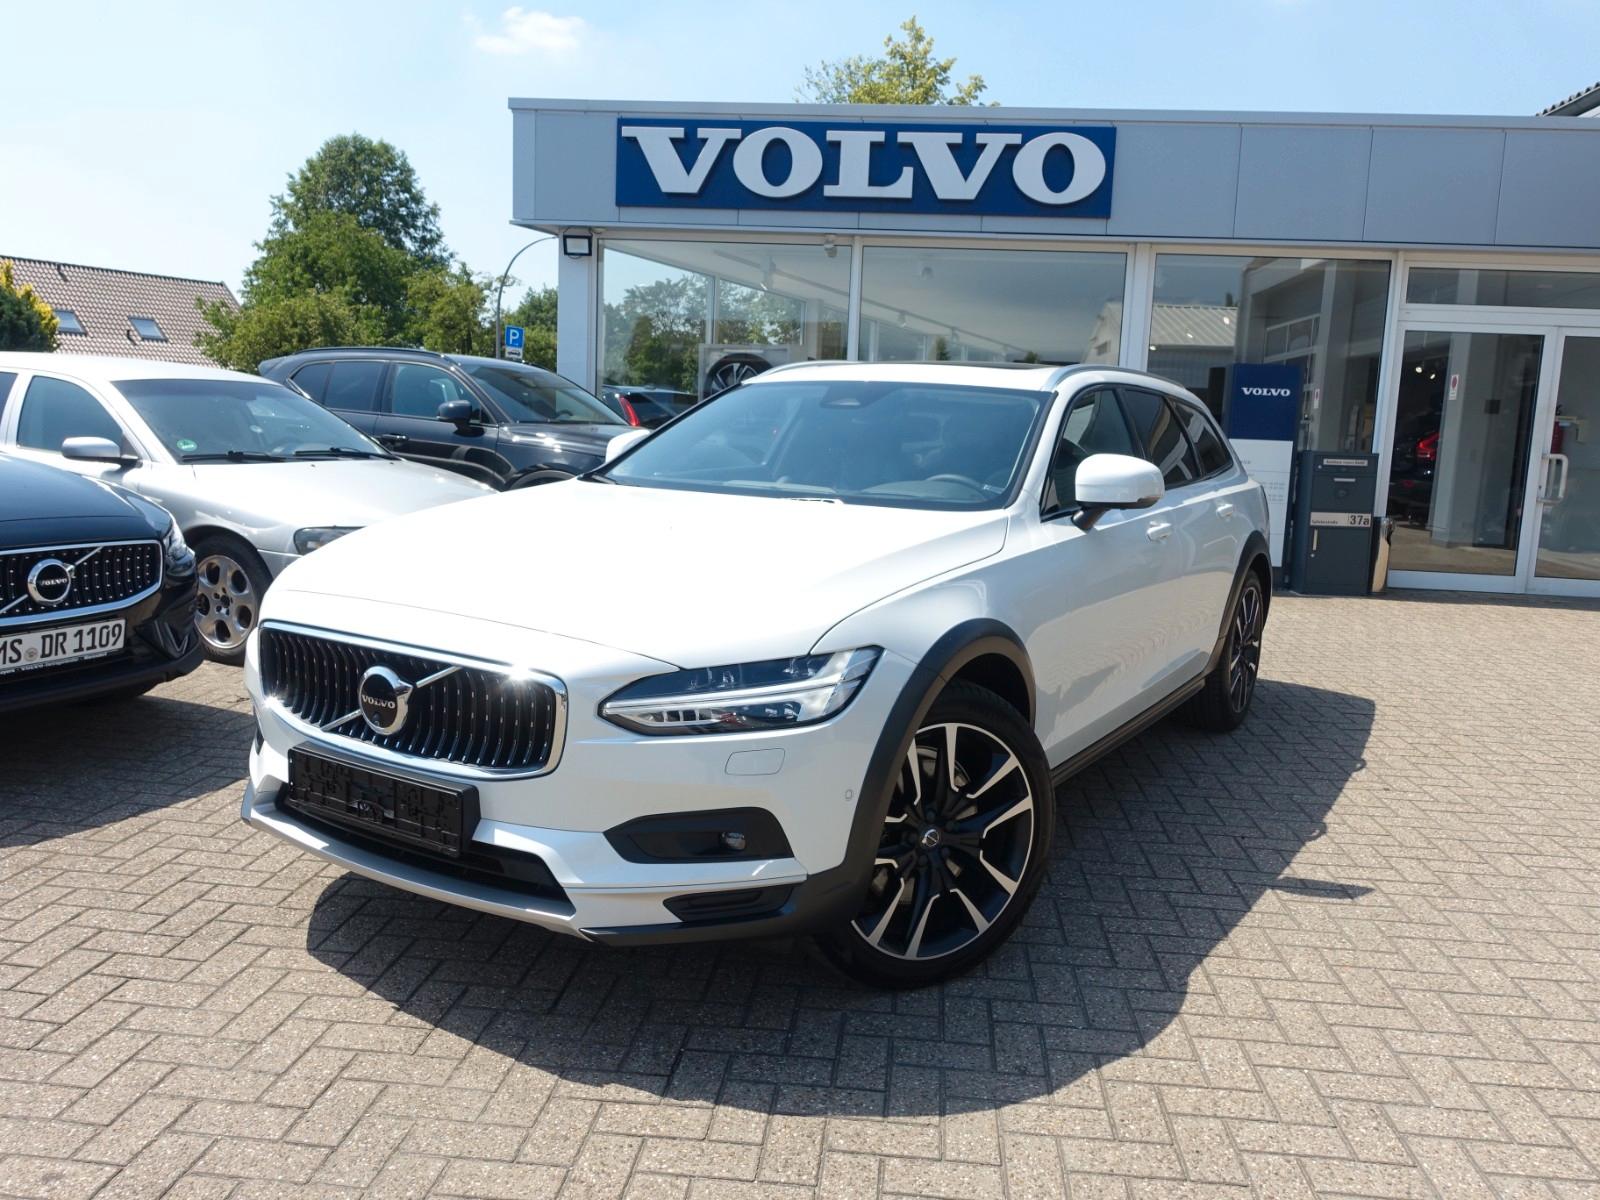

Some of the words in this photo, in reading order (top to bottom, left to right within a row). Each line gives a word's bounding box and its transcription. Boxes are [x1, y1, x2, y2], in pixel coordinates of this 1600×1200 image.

[621, 126, 1106, 205] VOLVO
[510, 329, 519, 344] P
[1241, 387, 1291, 397] VOLVO
[1350, 515, 1370, 526] 37a
[41, 578, 68, 586] VOLVO
[41, 631, 67, 658] DR
[73, 623, 122, 652] 1109
[361, 695, 396, 709] VOLVO
